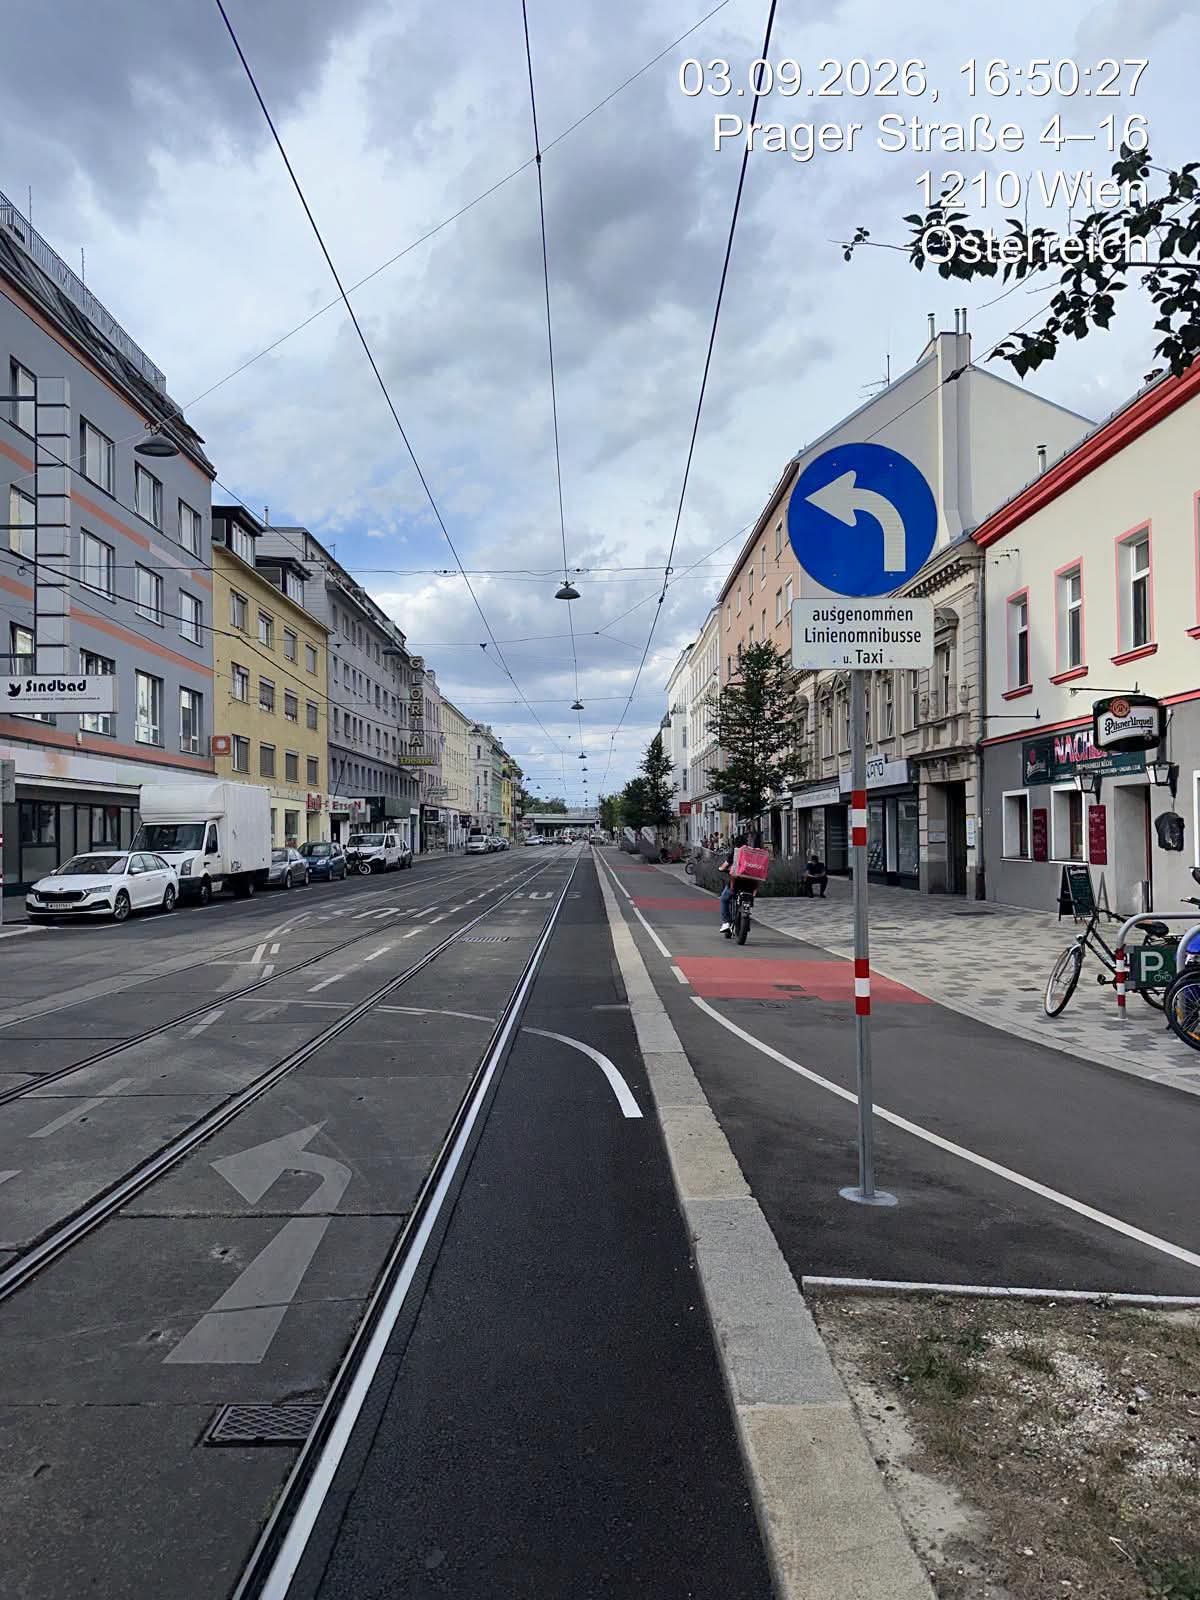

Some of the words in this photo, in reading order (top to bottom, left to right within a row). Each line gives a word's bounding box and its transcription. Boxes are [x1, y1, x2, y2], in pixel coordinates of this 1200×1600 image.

[812, 609, 913, 624] ausgenommen
[804, 627, 921, 643] Linienomnibusse
[843, 656, 852, 664] u.
[855, 649, 883, 664] Taxi
[25, 679, 87, 692] Sindbad
[410, 656, 424, 747] GLORIA
[1140, 951, 1164, 982] P
